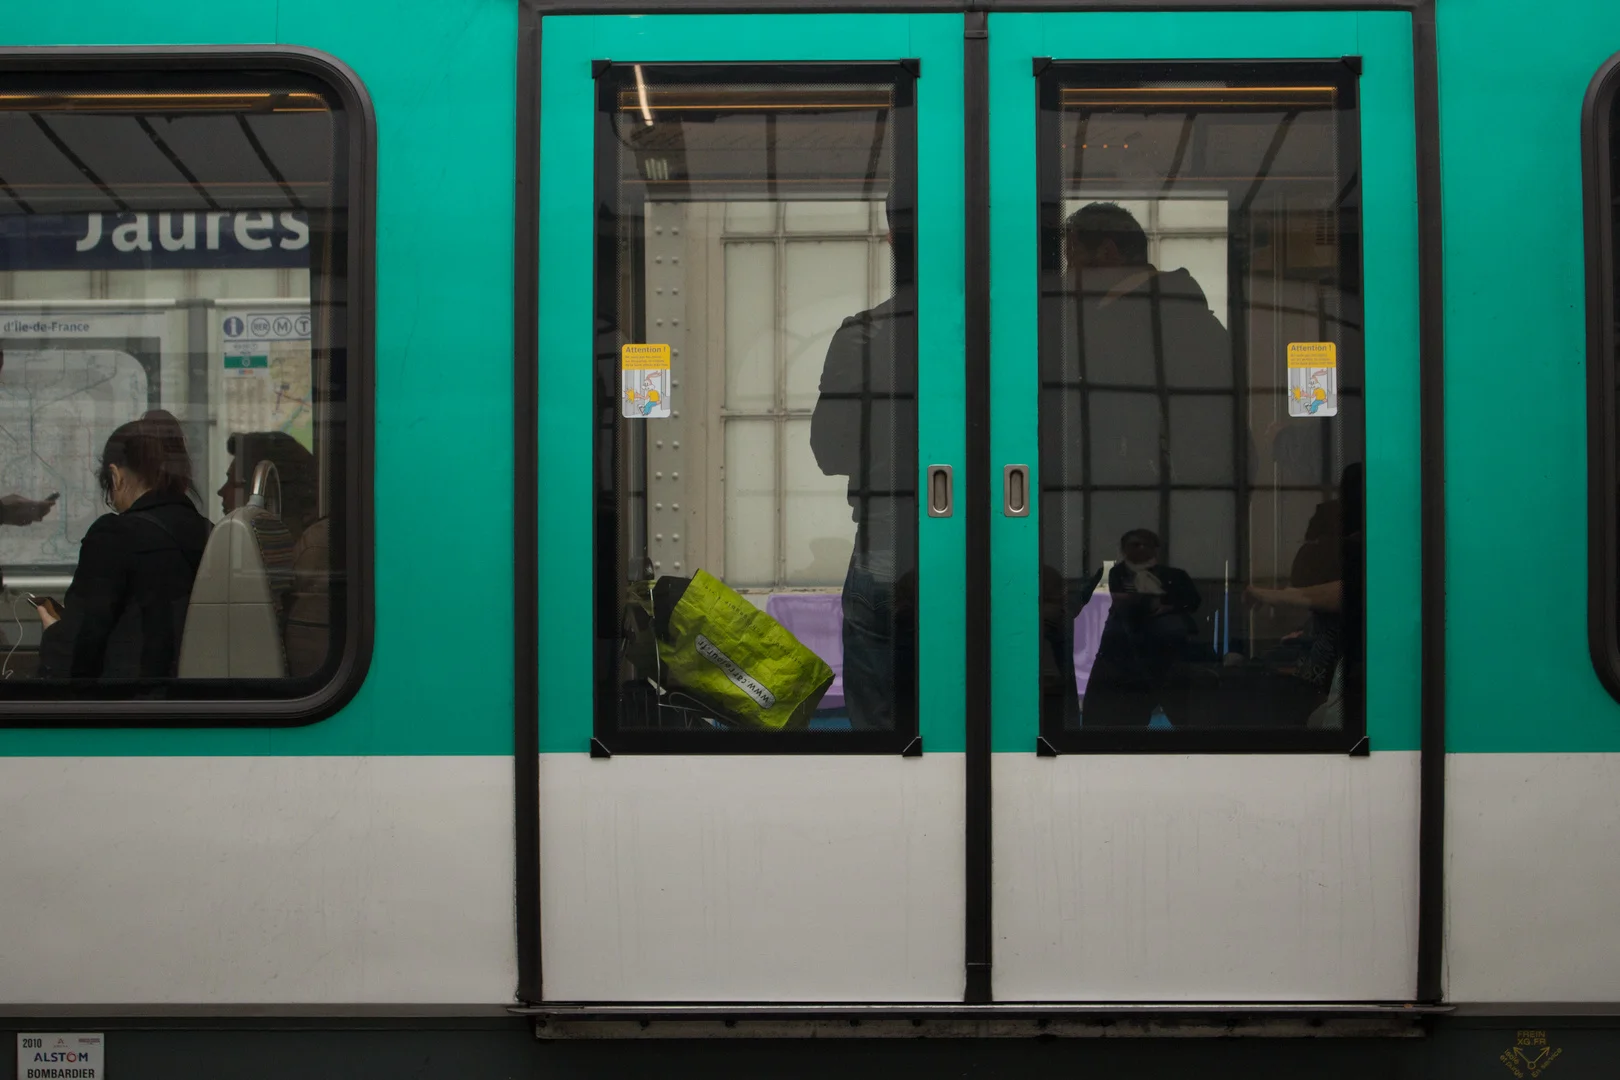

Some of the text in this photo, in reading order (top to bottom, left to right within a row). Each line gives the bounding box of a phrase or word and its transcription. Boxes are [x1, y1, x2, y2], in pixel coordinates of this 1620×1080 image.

[697, 640, 770, 704] www.carrefour.fr
[1517, 1030, 1546, 1038] FREIN
[22, 1038, 42, 1048] 2010
[34, 1051, 88, 1063] ALSTOM
[27, 1068, 95, 1079] BOMBARDIER
